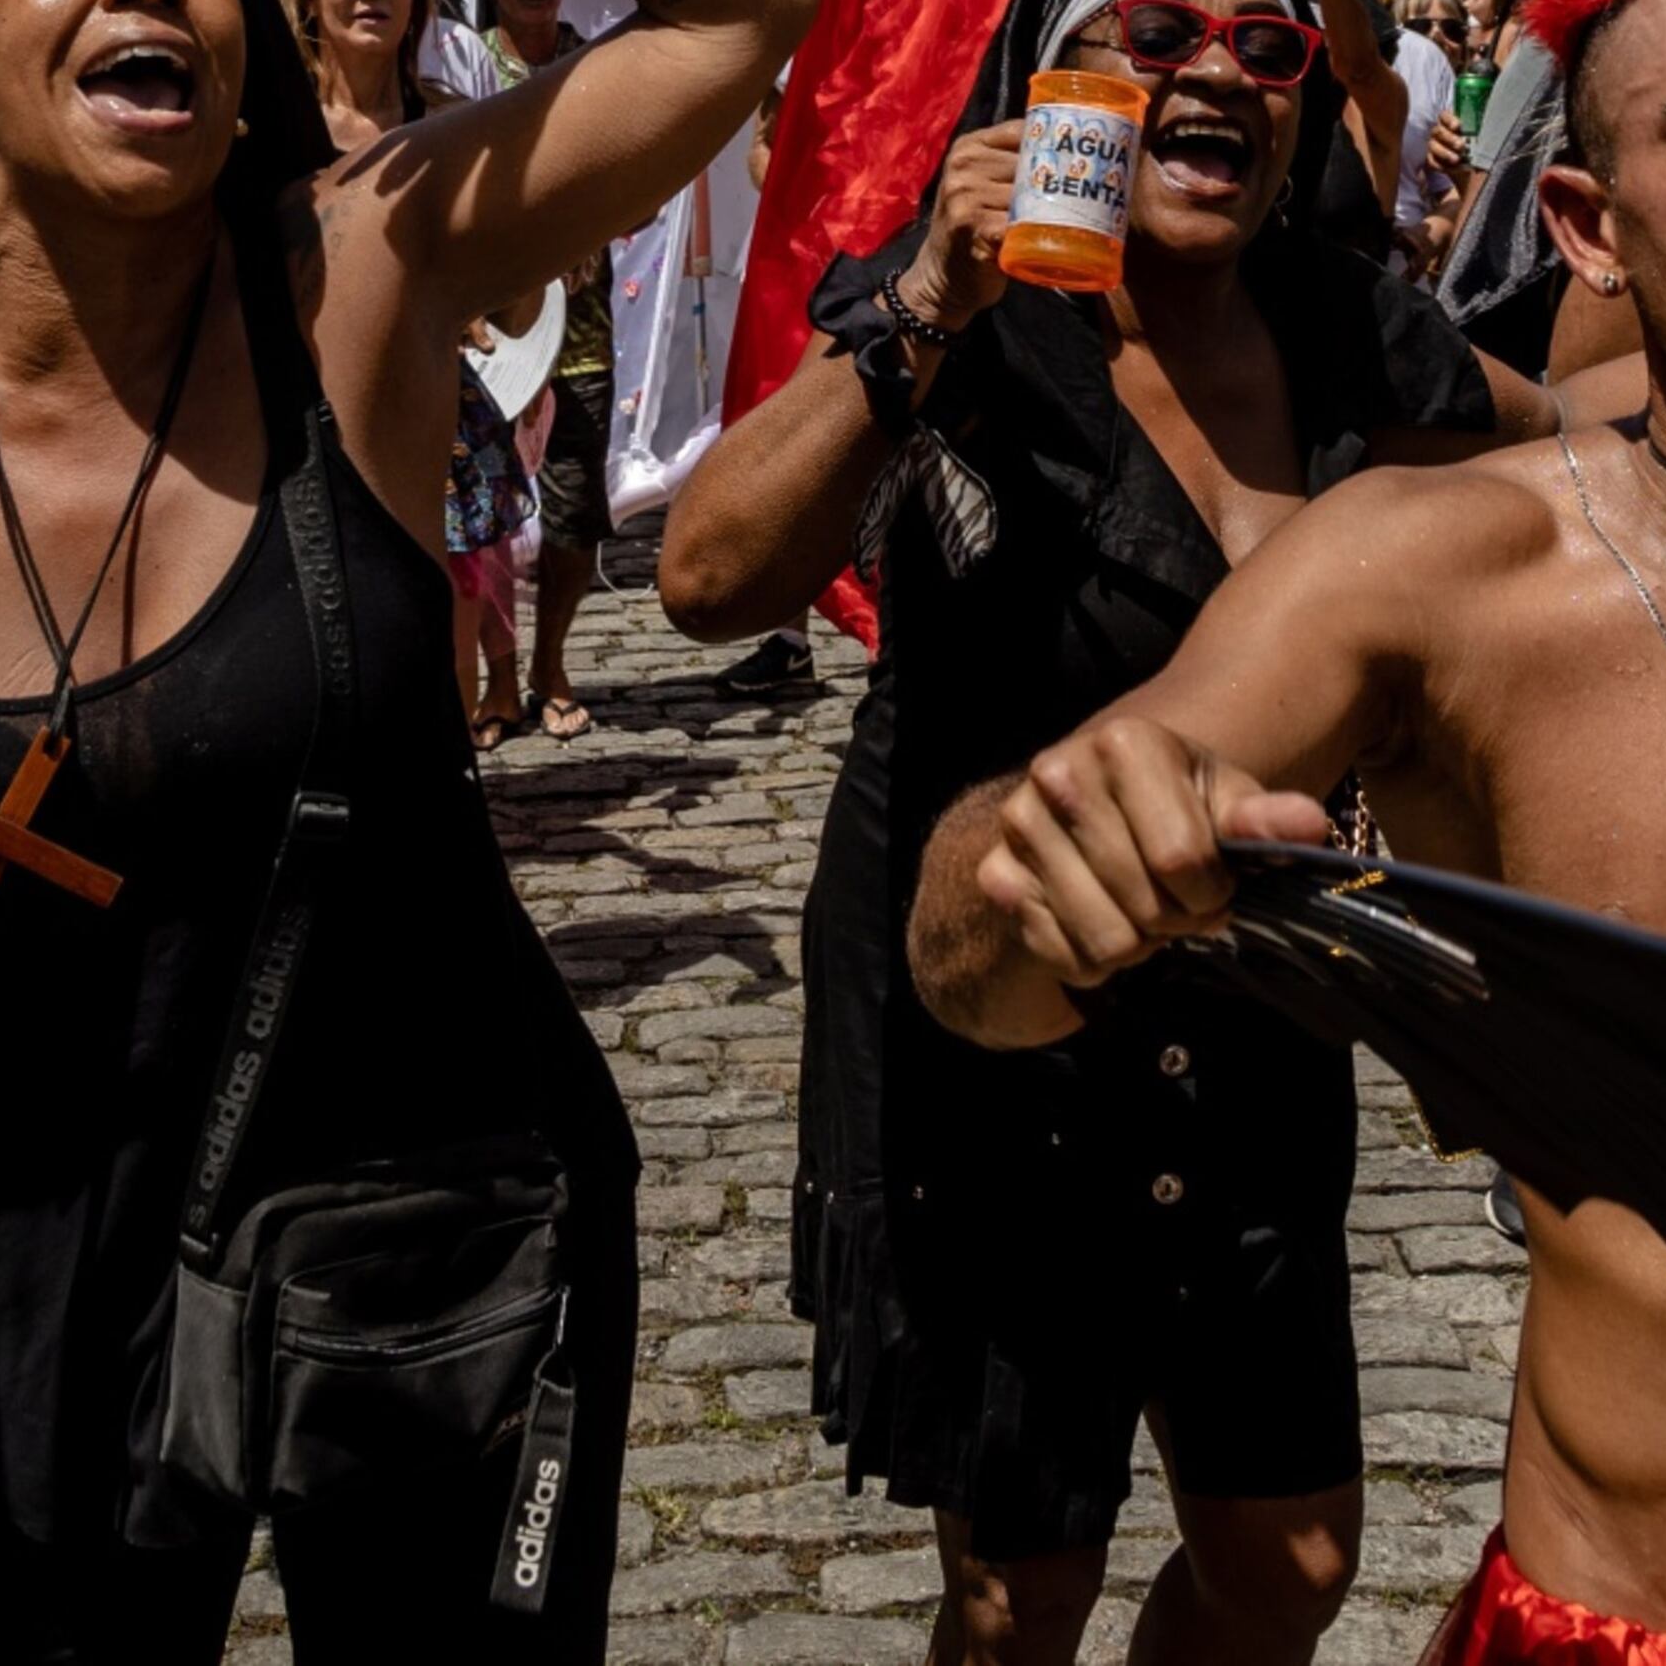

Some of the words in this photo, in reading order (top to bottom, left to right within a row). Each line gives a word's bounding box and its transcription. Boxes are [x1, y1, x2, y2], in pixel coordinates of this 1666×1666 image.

[1042, 173, 1127, 209] BENTA
[200, 1050, 262, 1192] adidas
[245, 904, 311, 1040] adidas
[514, 1458, 561, 1588] adidas
